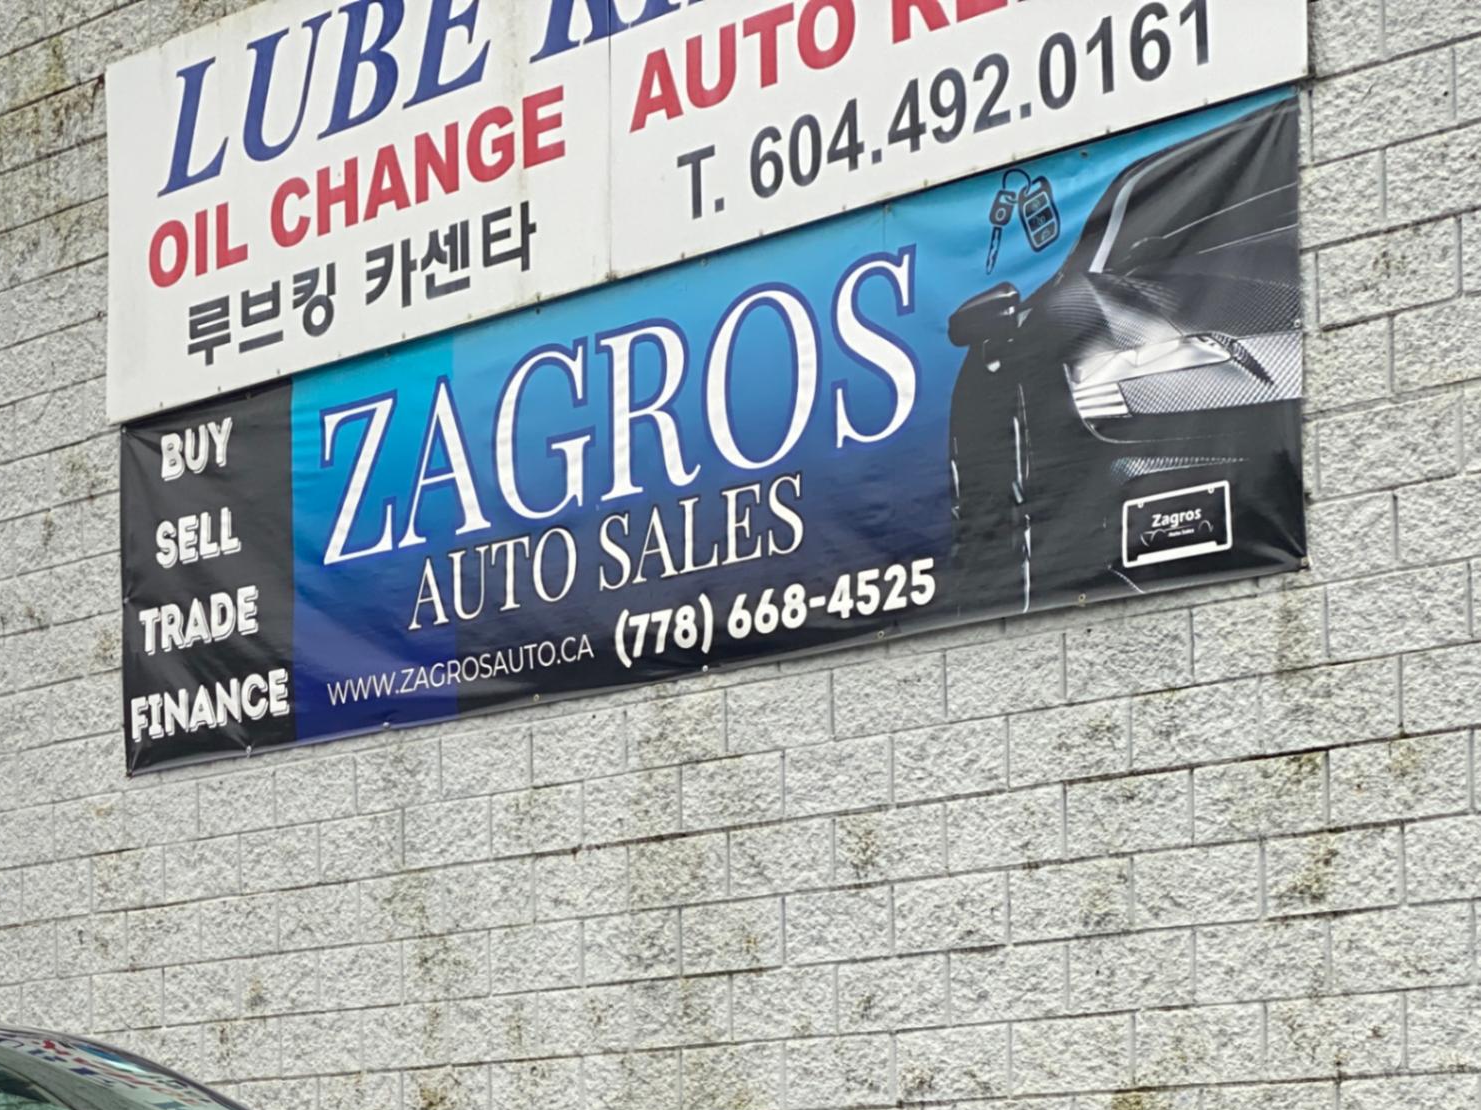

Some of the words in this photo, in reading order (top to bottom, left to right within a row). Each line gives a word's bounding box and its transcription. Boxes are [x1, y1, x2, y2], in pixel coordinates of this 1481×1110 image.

[158, 0, 491, 197] LUBE
[629, 0, 856, 132] AUTO
[677, 145, 725, 220] T.
[750, 0, 1211, 198] 604.492.0161
[149, 202, 248, 288] OIL
[270, 86, 565, 248] CHANGE
[188, 262, 337, 366] 루브킹
[365, 200, 537, 308] 카센타
[160, 417, 234, 481] BUY
[321, 250, 918, 567] ZAGROS
[155, 507, 241, 568] SELL
[408, 527, 578, 630] AUTO
[599, 474, 805, 592] SALES
[1151, 508, 1202, 528] Zagros
[139, 585, 259, 655] TRADE
[327, 634, 594, 706] WWW.ZAGROSAUTO.CA
[615, 593, 714, 668] (778)
[727, 558, 936, 639] 668-4525
[130, 668, 290, 742] FINANCE
